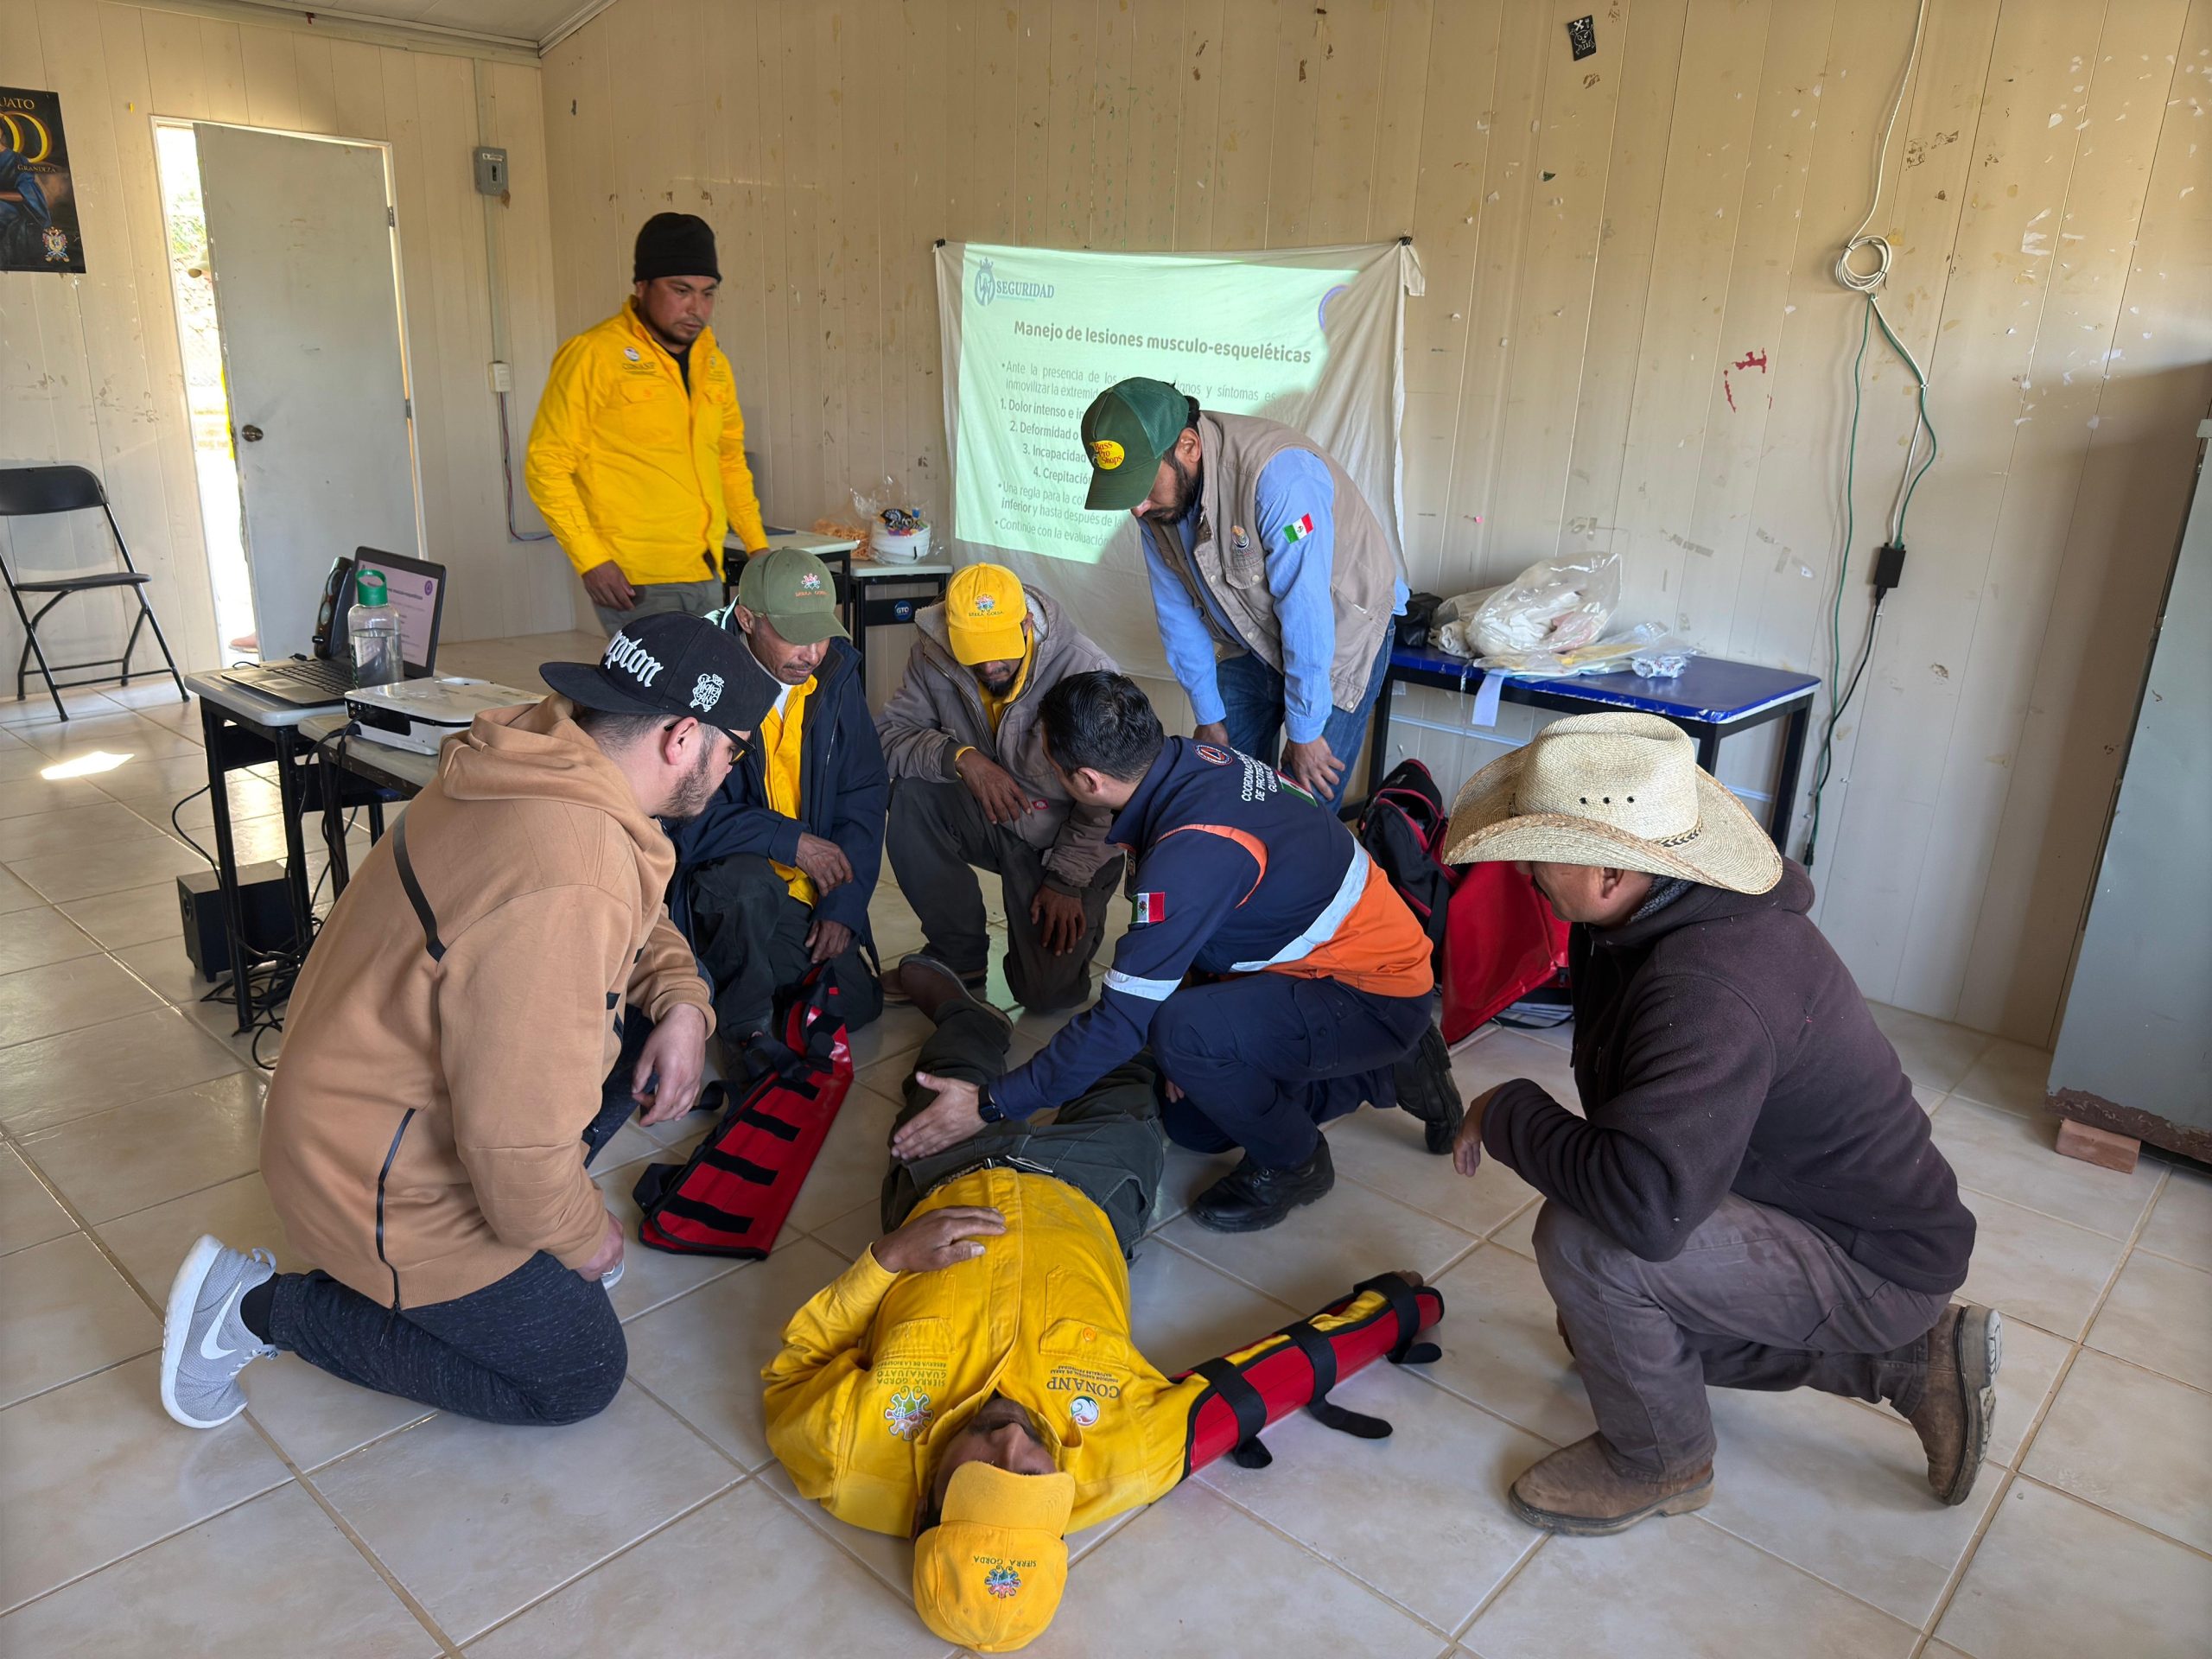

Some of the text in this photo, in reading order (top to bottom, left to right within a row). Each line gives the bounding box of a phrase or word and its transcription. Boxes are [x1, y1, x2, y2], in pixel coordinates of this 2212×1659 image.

[996, 280, 1055, 299] SEGURIDAD
[1014, 321, 1311, 364] Manejo de lesiones musculo-esqueléticas
[1006, 361, 1026, 374] Ante
[1031, 363, 1038, 375] la
[1043, 366, 1084, 380] presencia
[1089, 371, 1100, 383] de
[1104, 372, 1116, 385] los
[1177, 381, 1201, 395] ignos
[1206, 385, 1213, 398] y
[1217, 385, 1259, 401] síntomas
[1006, 378, 1098, 398] inmovilizar la extremid
[1001, 398, 1007, 410] 1.
[1008, 399, 1032, 414] Dolor
[1033, 403, 1065, 417] intenso
[1068, 410, 1074, 418] e
[1010, 421, 1079, 441] 2. Deformidad o
[1023, 443, 1030, 455] 3.
[1099, 448, 1110, 457] Pro
[1102, 455, 1122, 465] Shops
[1033, 467, 1041, 478] 4.
[1003, 481, 1085, 505] Una regla para la col
[1001, 498, 1122, 528] inferior y hasta después de la
[1000, 518, 1109, 547] Continúe con la evaluación
[1255, 789, 1265, 802] DE
[877, 1370, 946, 1379] GUANAJUATO
[915, 1378, 945, 1387] SIERRA
[1046, 1376, 1121, 1398] CONANP
[973, 1555, 1003, 1565] GORDA
